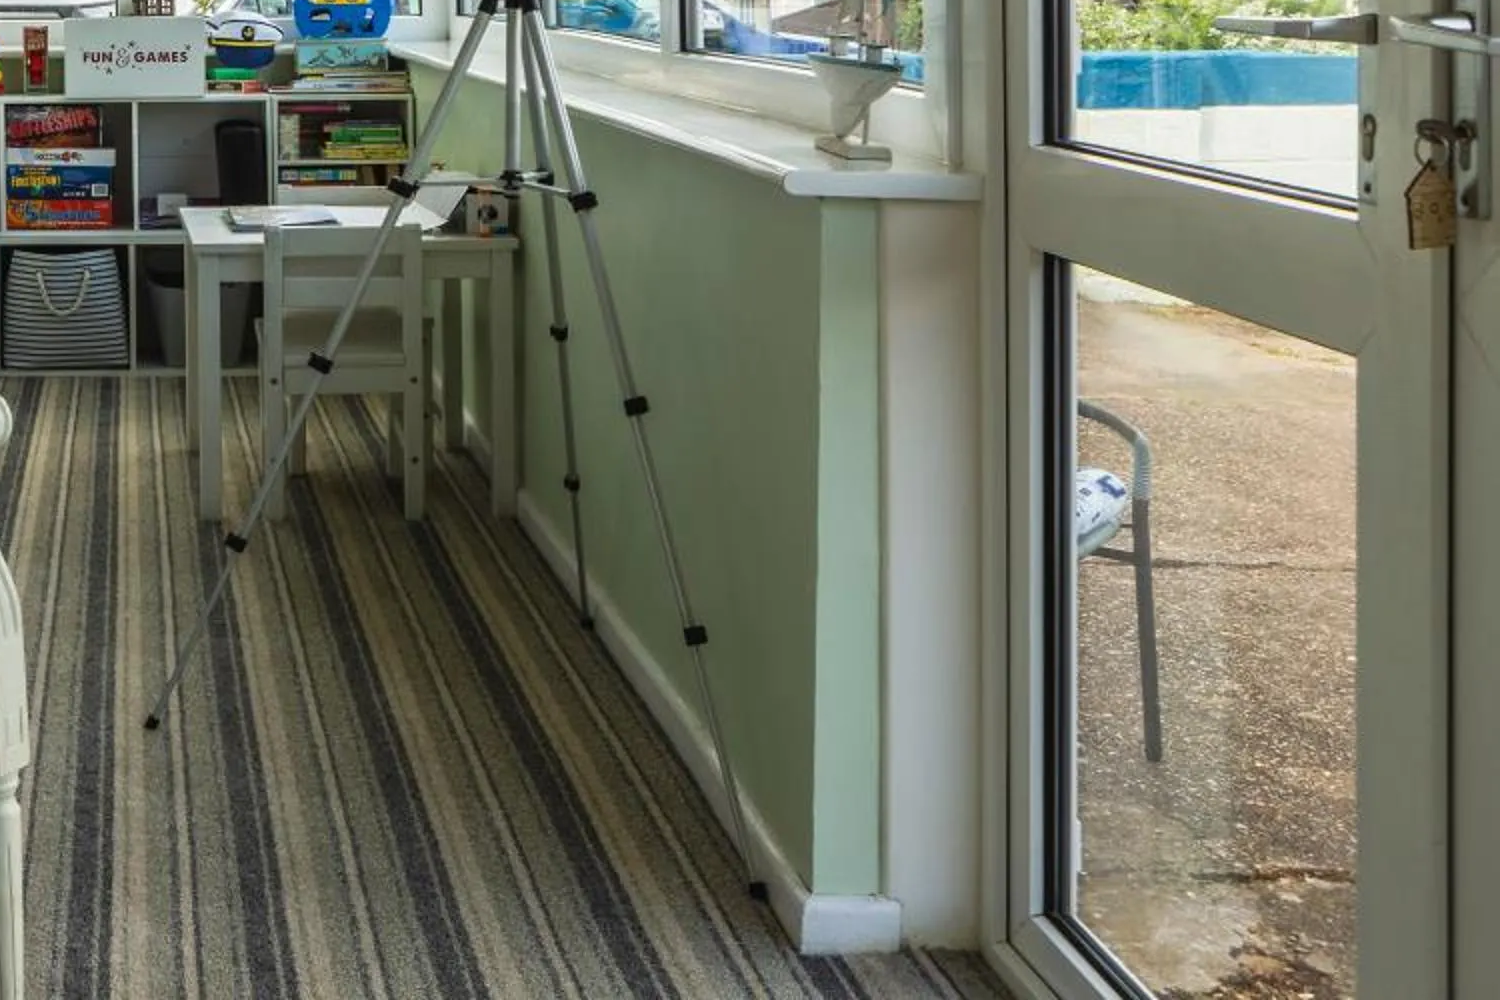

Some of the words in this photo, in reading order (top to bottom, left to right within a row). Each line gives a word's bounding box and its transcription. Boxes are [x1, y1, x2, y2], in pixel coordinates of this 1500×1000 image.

[83, 51, 113, 63] FUN
[115, 47, 131, 68] &
[134, 51, 189, 63] GAMES
